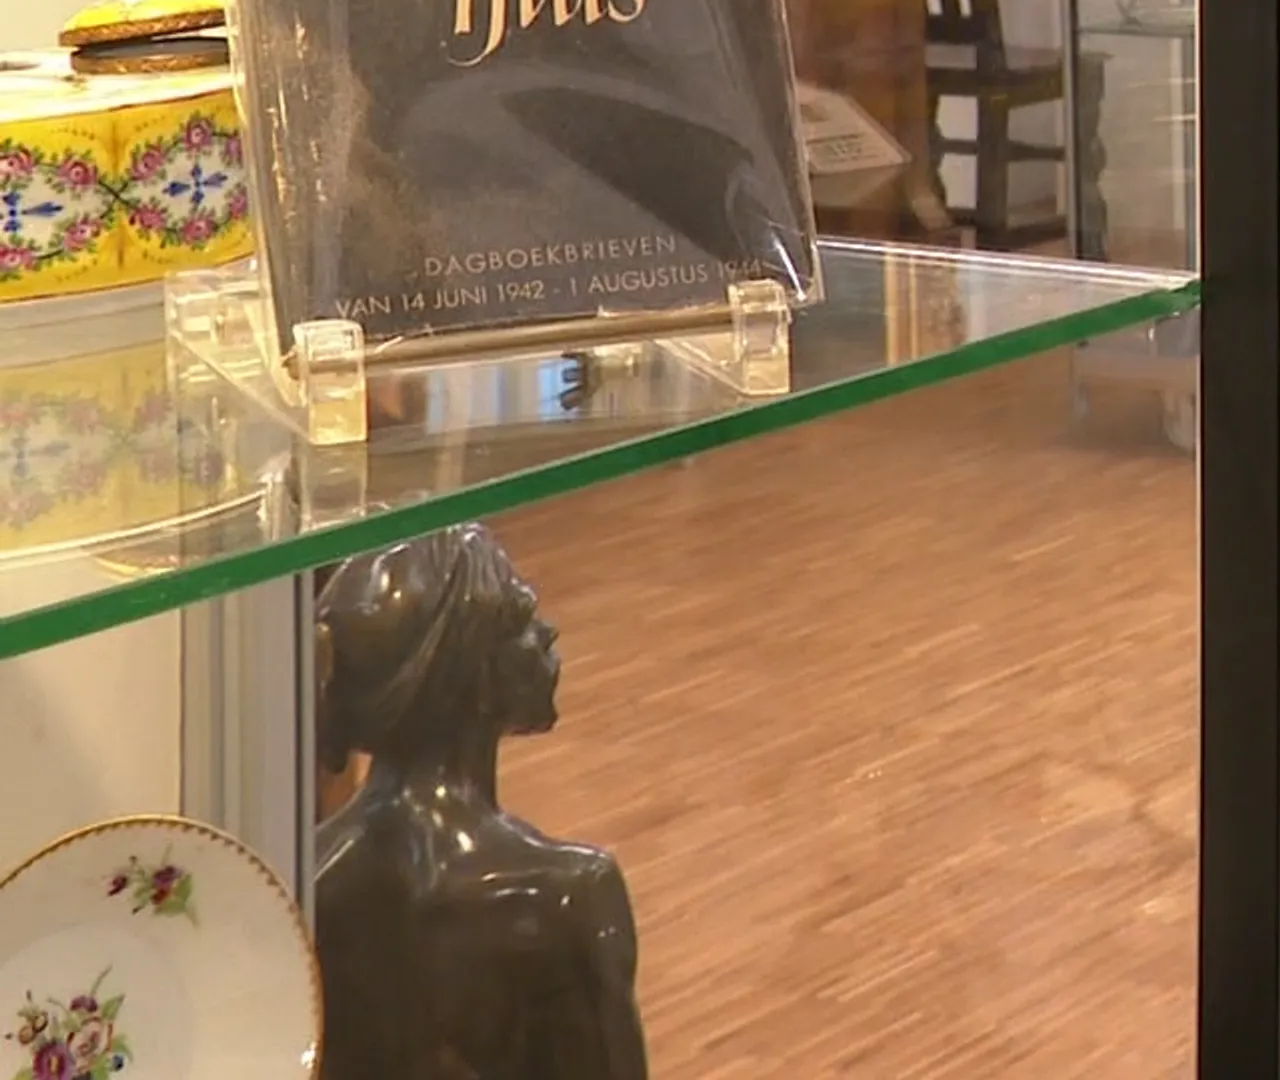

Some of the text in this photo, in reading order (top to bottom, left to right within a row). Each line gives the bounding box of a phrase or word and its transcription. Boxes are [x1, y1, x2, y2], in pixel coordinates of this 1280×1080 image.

[424, 235, 676, 277] DAGBOEKBRIEVEN
[335, 295, 392, 319] VAN
[402, 291, 425, 313] 14
[434, 285, 487, 310] JUNI
[498, 279, 545, 303] 1942
[588, 263, 708, 295] AUGUSTUS
